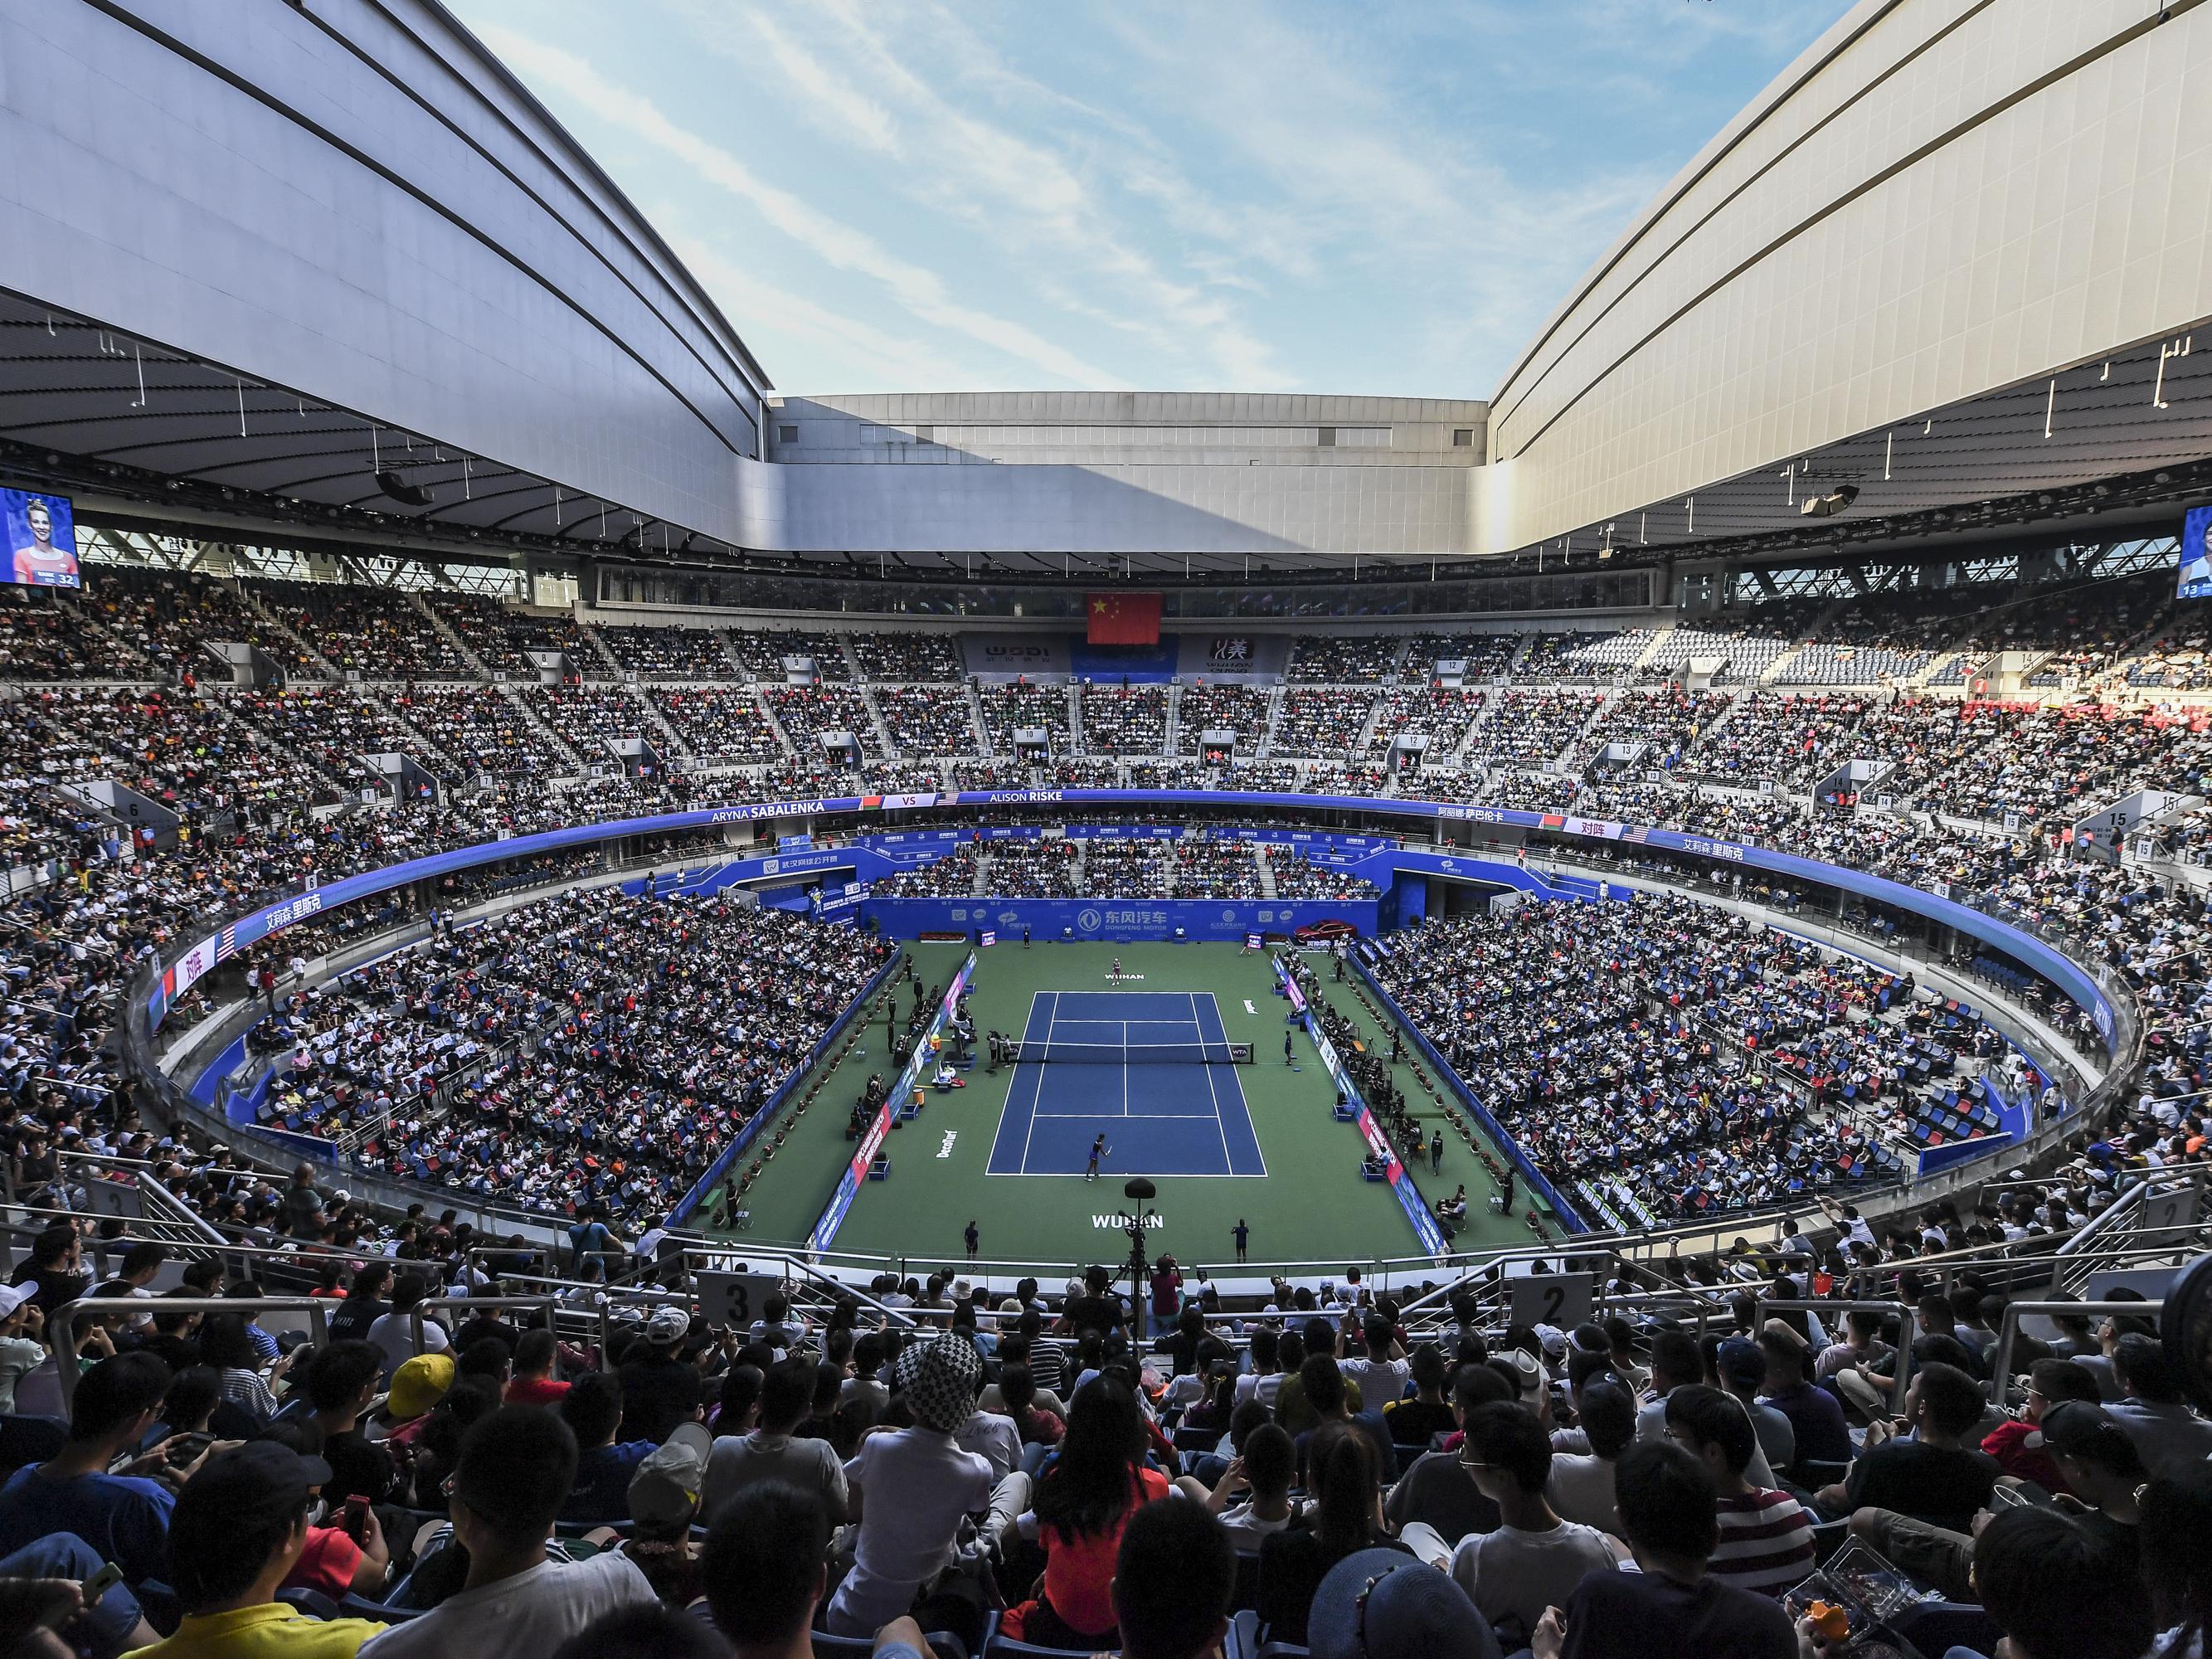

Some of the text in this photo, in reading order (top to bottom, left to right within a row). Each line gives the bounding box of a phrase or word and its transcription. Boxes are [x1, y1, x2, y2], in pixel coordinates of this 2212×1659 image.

[58, 574, 75, 585] 32
[2183, 585, 2199, 596] 13
[2022, 654, 2032, 663] 14
[1622, 746, 1631, 754] 13
[377, 757, 382, 766] 7
[1868, 763, 1878, 774] 14
[484, 776, 488, 785] 7
[1834, 777, 1843, 787] 14
[82, 786, 91, 800] 6
[366, 791, 370, 799] 7
[990, 791, 1062, 803] ALISON RISKE
[902, 797, 916, 806] VS
[2162, 795, 2176, 810] 15
[129, 804, 139, 816] 6
[712, 801, 825, 823] ARYNA SABALENKA
[2008, 818, 2015, 827] 15
[2109, 812, 2127, 825] 15
[1581, 822, 1605, 837] 对阵
[2141, 844, 2148, 854] 15
[309, 878, 314, 888] 6
[1940, 886, 1946, 896] 15
[1106, 911, 1167, 924] 东风汽车
[1367, 1115, 1385, 1146] UPCOMING
[856, 1129, 875, 1164] UPCOMING
[873, 1112, 885, 1134] MATCH
[936, 1130, 958, 1158] DecoTurf
[727, 1284, 748, 1322] 3
[1543, 1287, 1566, 1324] 2
